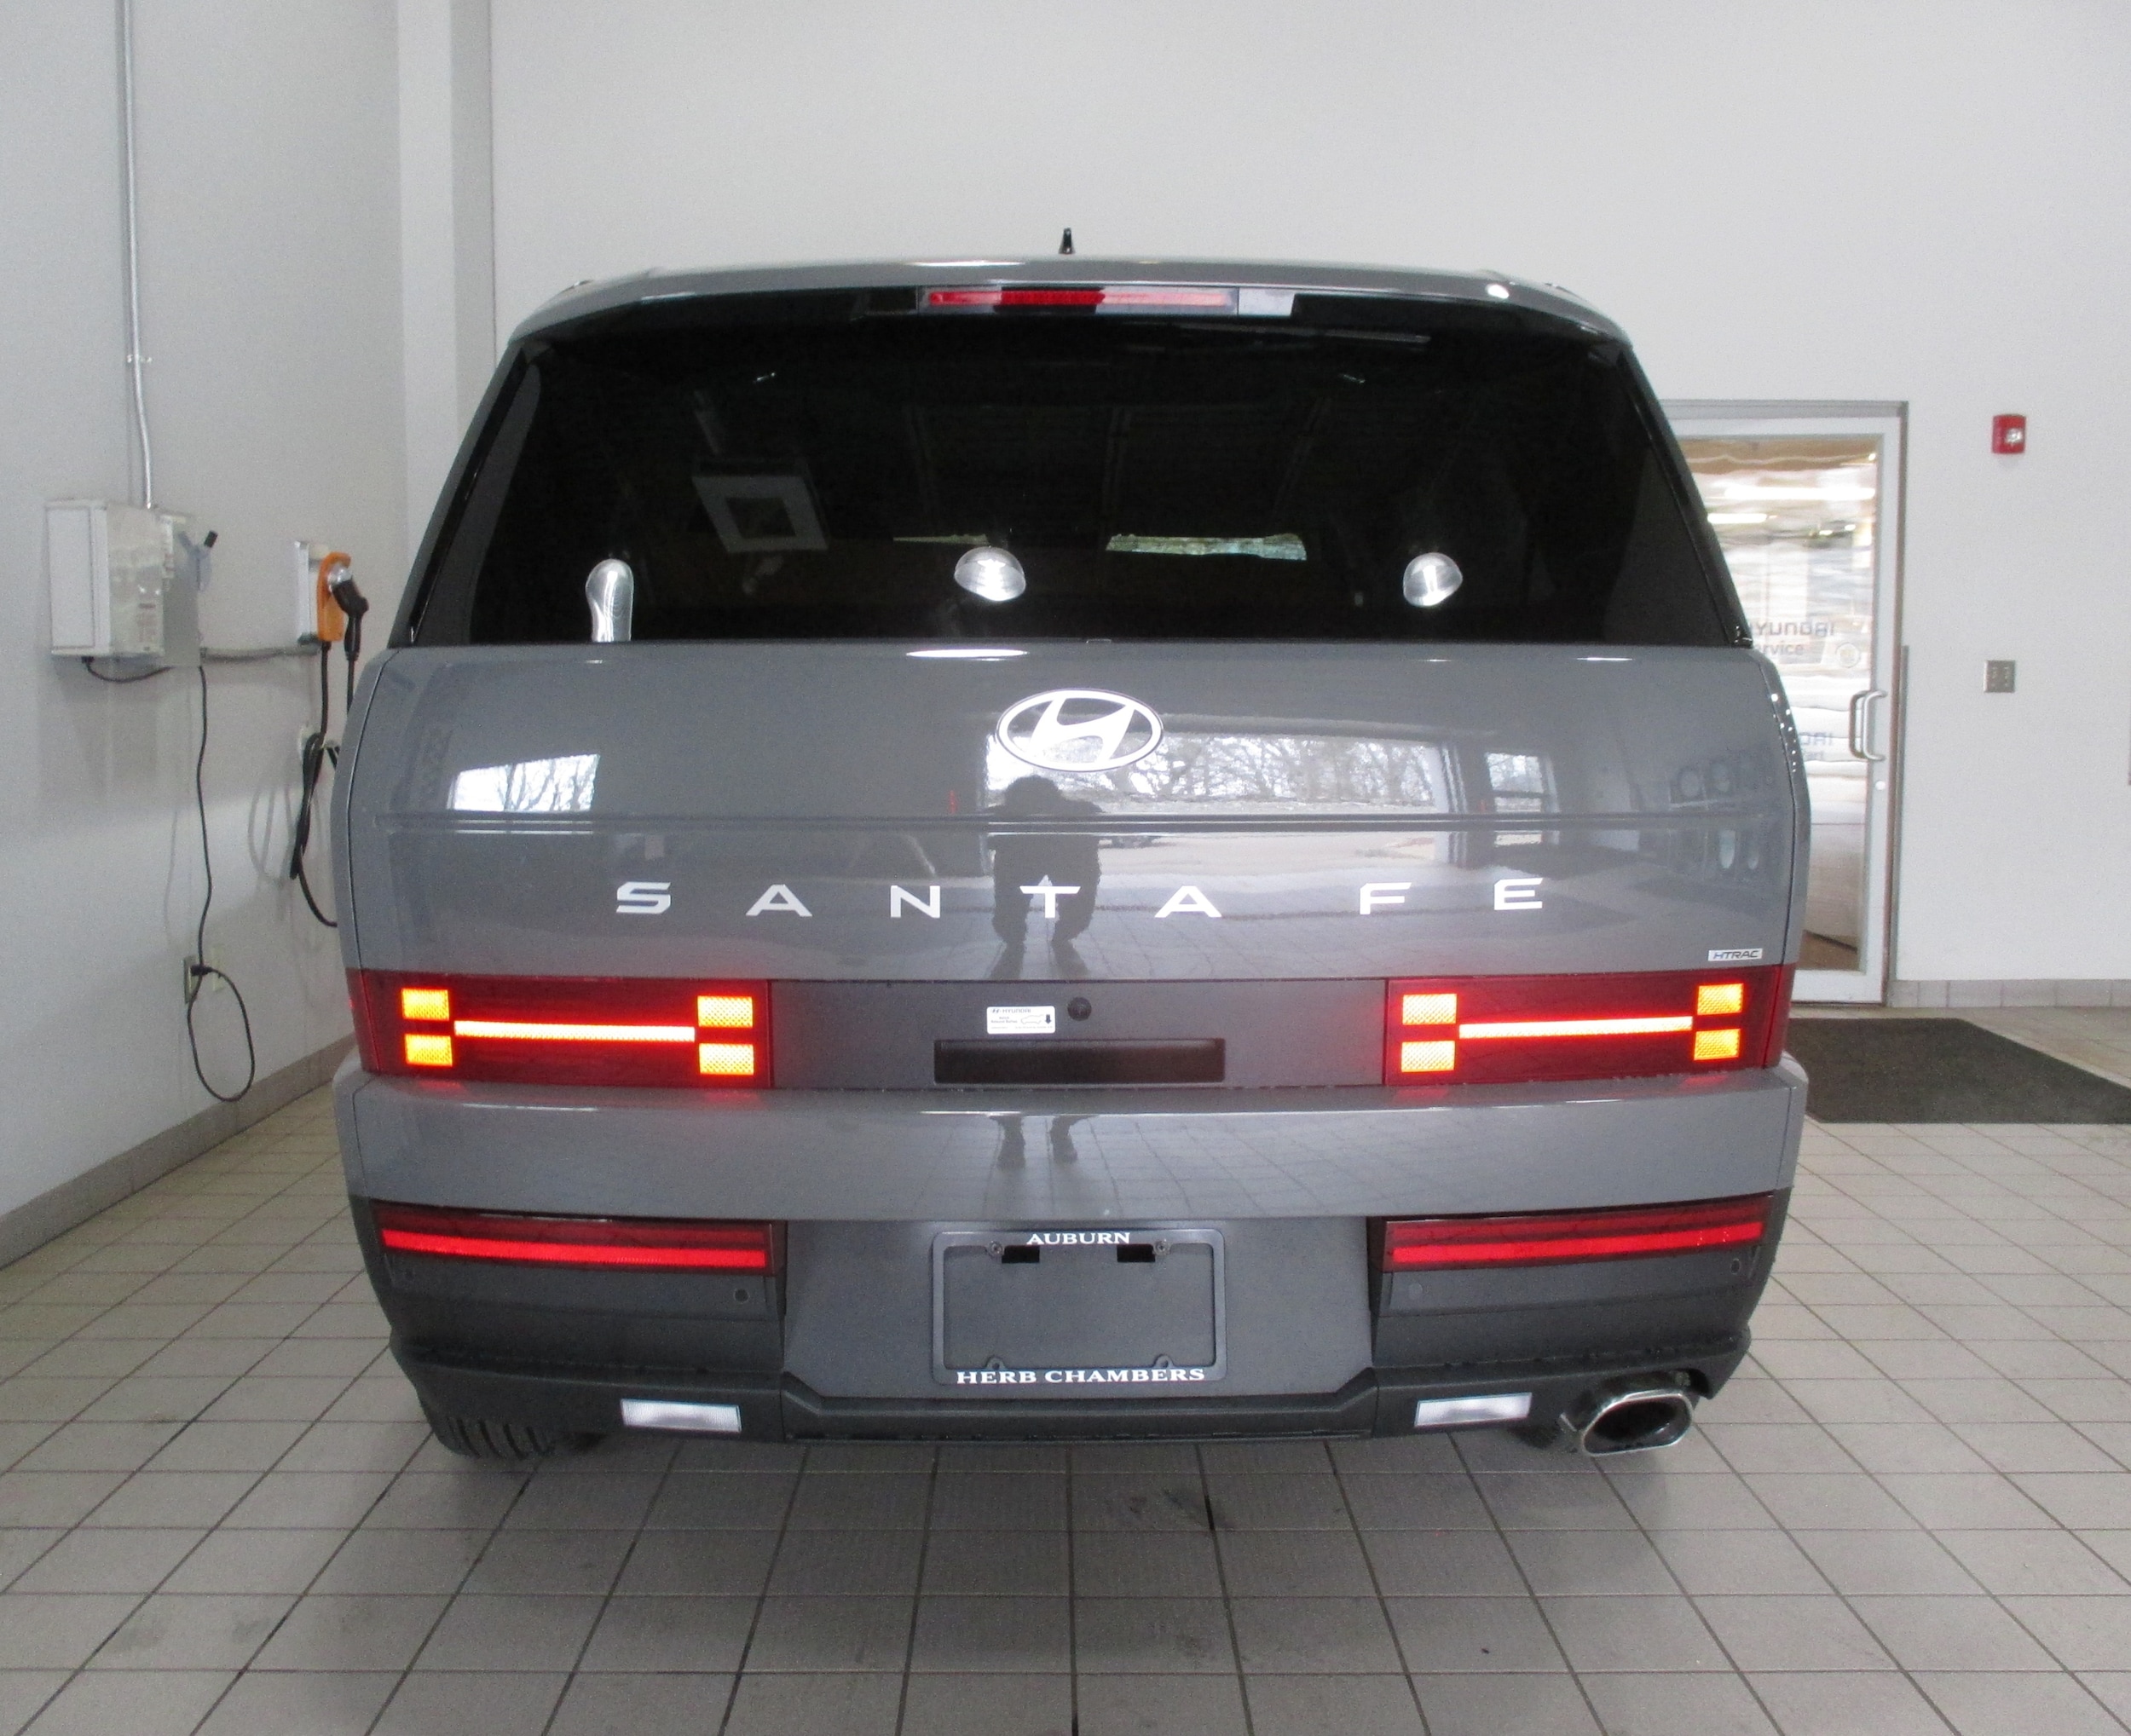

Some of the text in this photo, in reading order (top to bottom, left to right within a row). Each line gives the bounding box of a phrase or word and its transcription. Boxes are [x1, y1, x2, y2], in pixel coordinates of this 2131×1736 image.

[1750, 621, 1834, 637] YUNDAI
[1754, 640, 1805, 655] ervice
[616, 877, 1544, 919] SANTA FE
[1713, 949, 1759, 960] HTRAC
[1025, 1232, 1131, 1245] AUBURN
[956, 1368, 1205, 1384] HERB CHAMBERS
